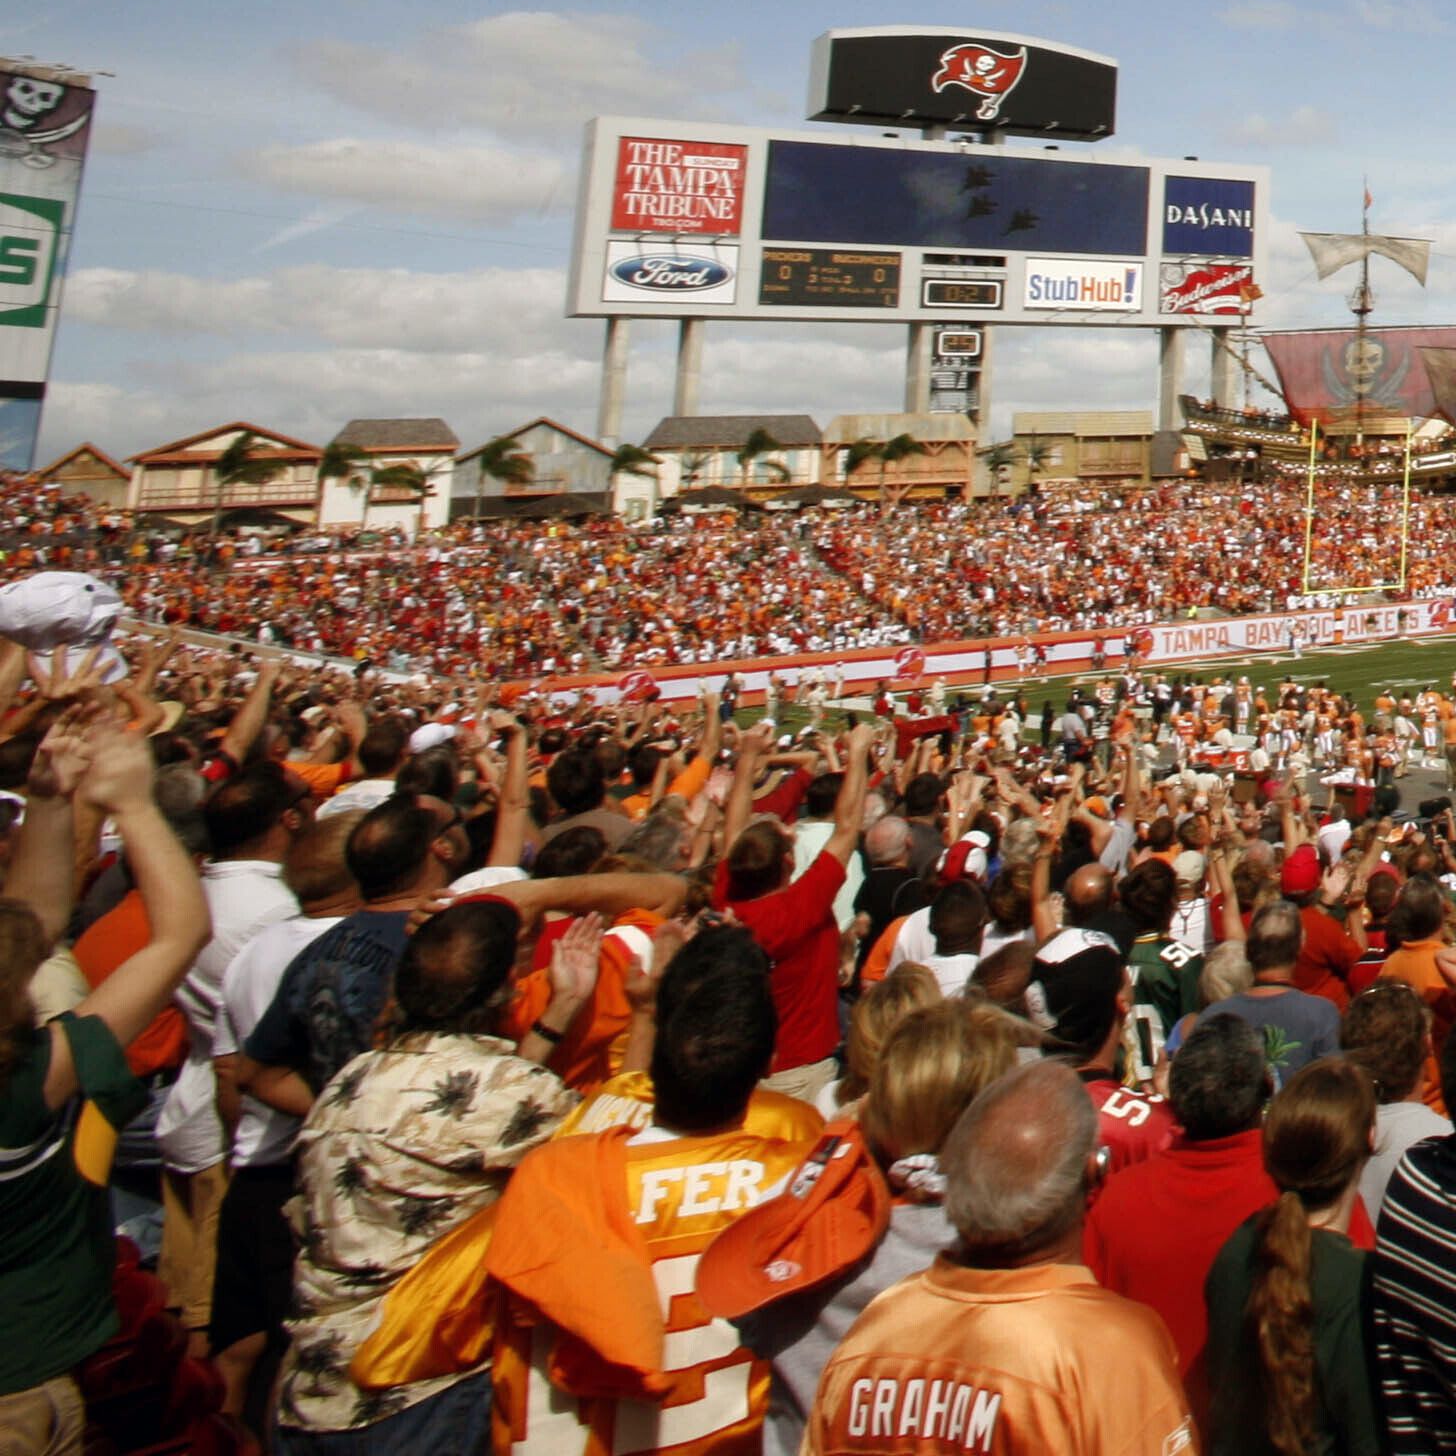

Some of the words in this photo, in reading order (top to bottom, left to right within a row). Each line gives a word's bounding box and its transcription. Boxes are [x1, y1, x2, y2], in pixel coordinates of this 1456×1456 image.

[627, 142, 683, 165] THE
[626, 164, 736, 198] TAMPA
[623, 193, 735, 220] TRIBUNE
[1167, 202, 1250, 230] DASANI
[632, 258, 711, 286] Ford
[1029, 267, 1136, 304] StubHub!
[1161, 266, 1251, 313] Budweiser
[1162, 625, 1230, 654] TAMPA
[1245, 620, 1284, 646] BAY
[631, 1158, 766, 1226] FER
[848, 1377, 1001, 1452] GRAHAM
